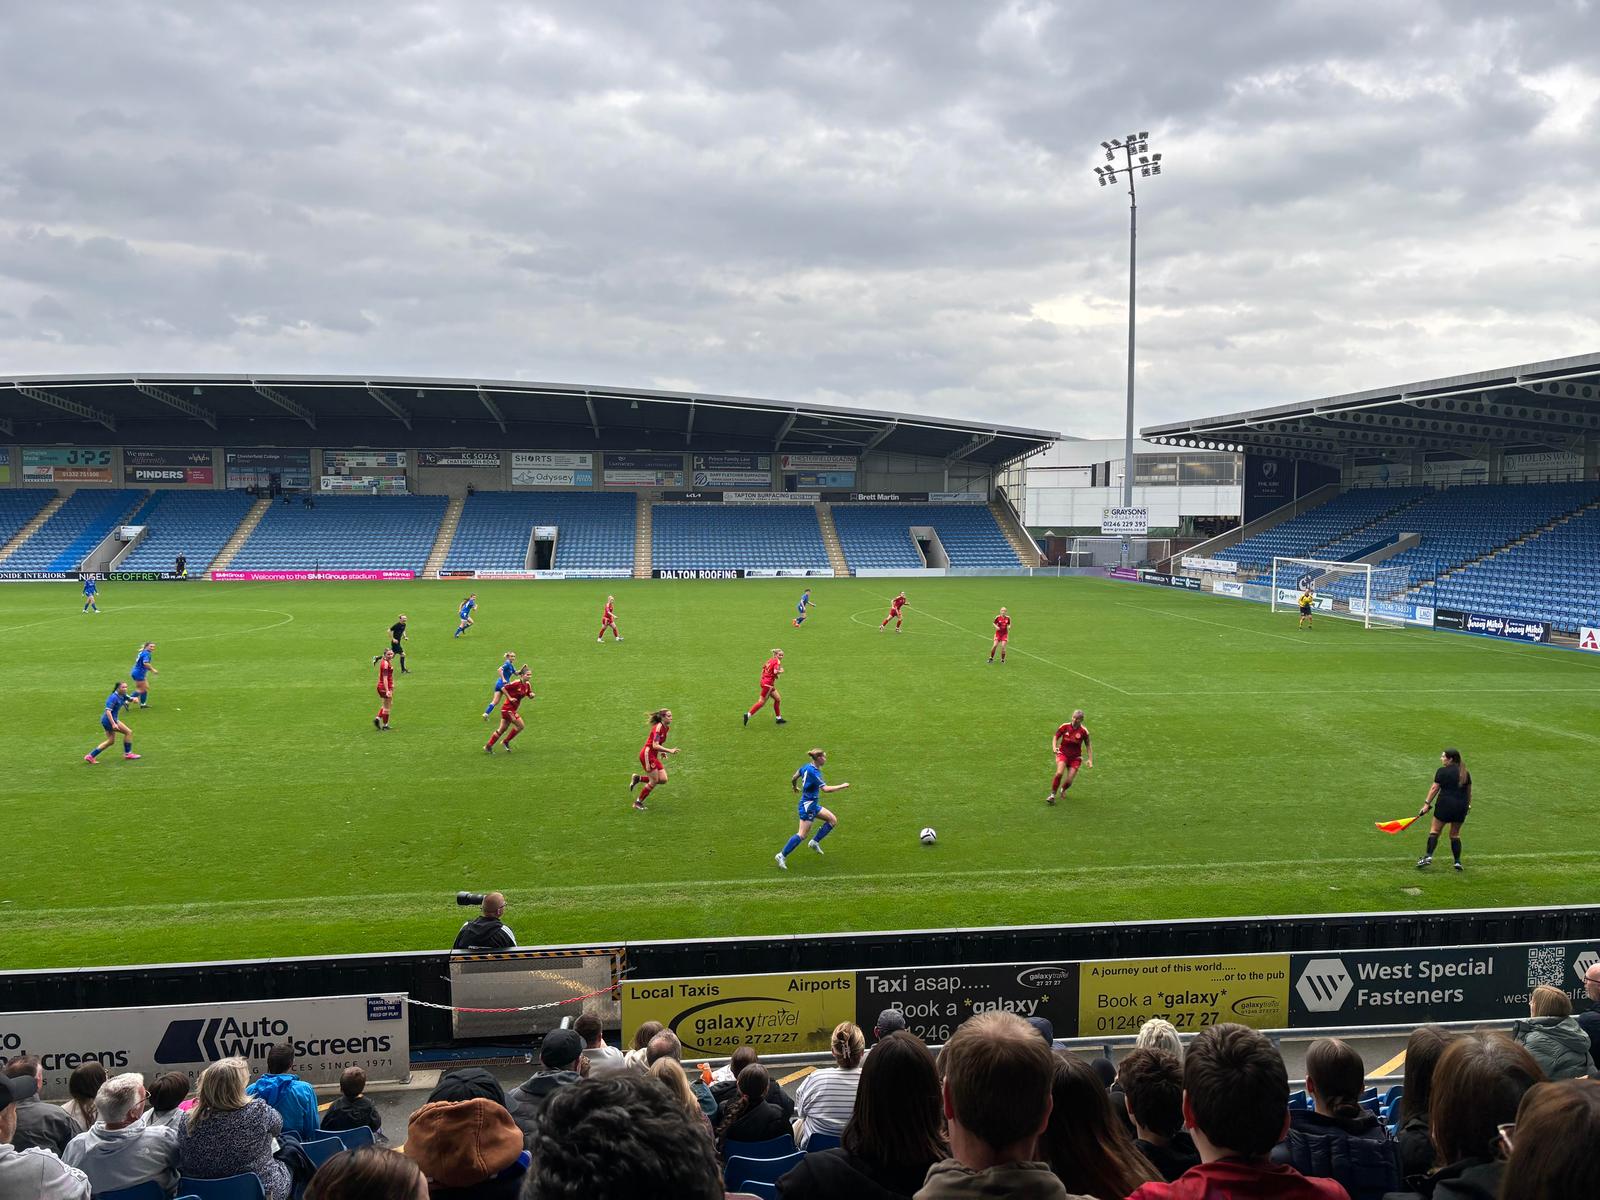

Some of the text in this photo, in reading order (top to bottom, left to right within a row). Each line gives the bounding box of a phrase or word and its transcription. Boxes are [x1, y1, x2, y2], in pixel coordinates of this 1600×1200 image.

[136, 470, 184, 479] PINDERS
[536, 472, 574, 484] Odyssey
[858, 492, 900, 500] Brett Martin
[1111, 508, 1147, 516] GRAYSONS
[109, 573, 160, 581] GEOFFREY
[660, 570, 737, 579] DALTON ROOFING
[1091, 968, 1099, 976] A
[1101, 966, 1139, 978] journey
[1142, 966, 1158, 974] out
[1161, 964, 1171, 973] of
[1173, 963, 1191, 972] this
[1237, 972, 1246, 980] to
[1249, 972, 1264, 980] the
[1266, 971, 1285, 982] pub
[1357, 957, 1493, 982] West Special
[788, 977, 850, 993] Airports
[866, 975, 907, 993] Taxi
[631, 984, 720, 1000] Local Taxis
[1357, 987, 1464, 1006] Fasteners
[1098, 993, 1138, 1009] Book
[1143, 996, 1152, 1006] a
[891, 1001, 939, 1018] Book
[946, 1003, 957, 1016] a
[220, 1017, 289, 1039] Auto
[1097, 1015, 1145, 1031] 01246
[1176, 1013, 1193, 1027] 27
[1200, 1012, 1220, 1026] 27
[697, 1032, 799, 1047] 01246 272727
[220, 1035, 391, 1060] Winscreens
[320, 1060, 358, 1070] SINCE
[366, 1059, 392, 1067] 1971
